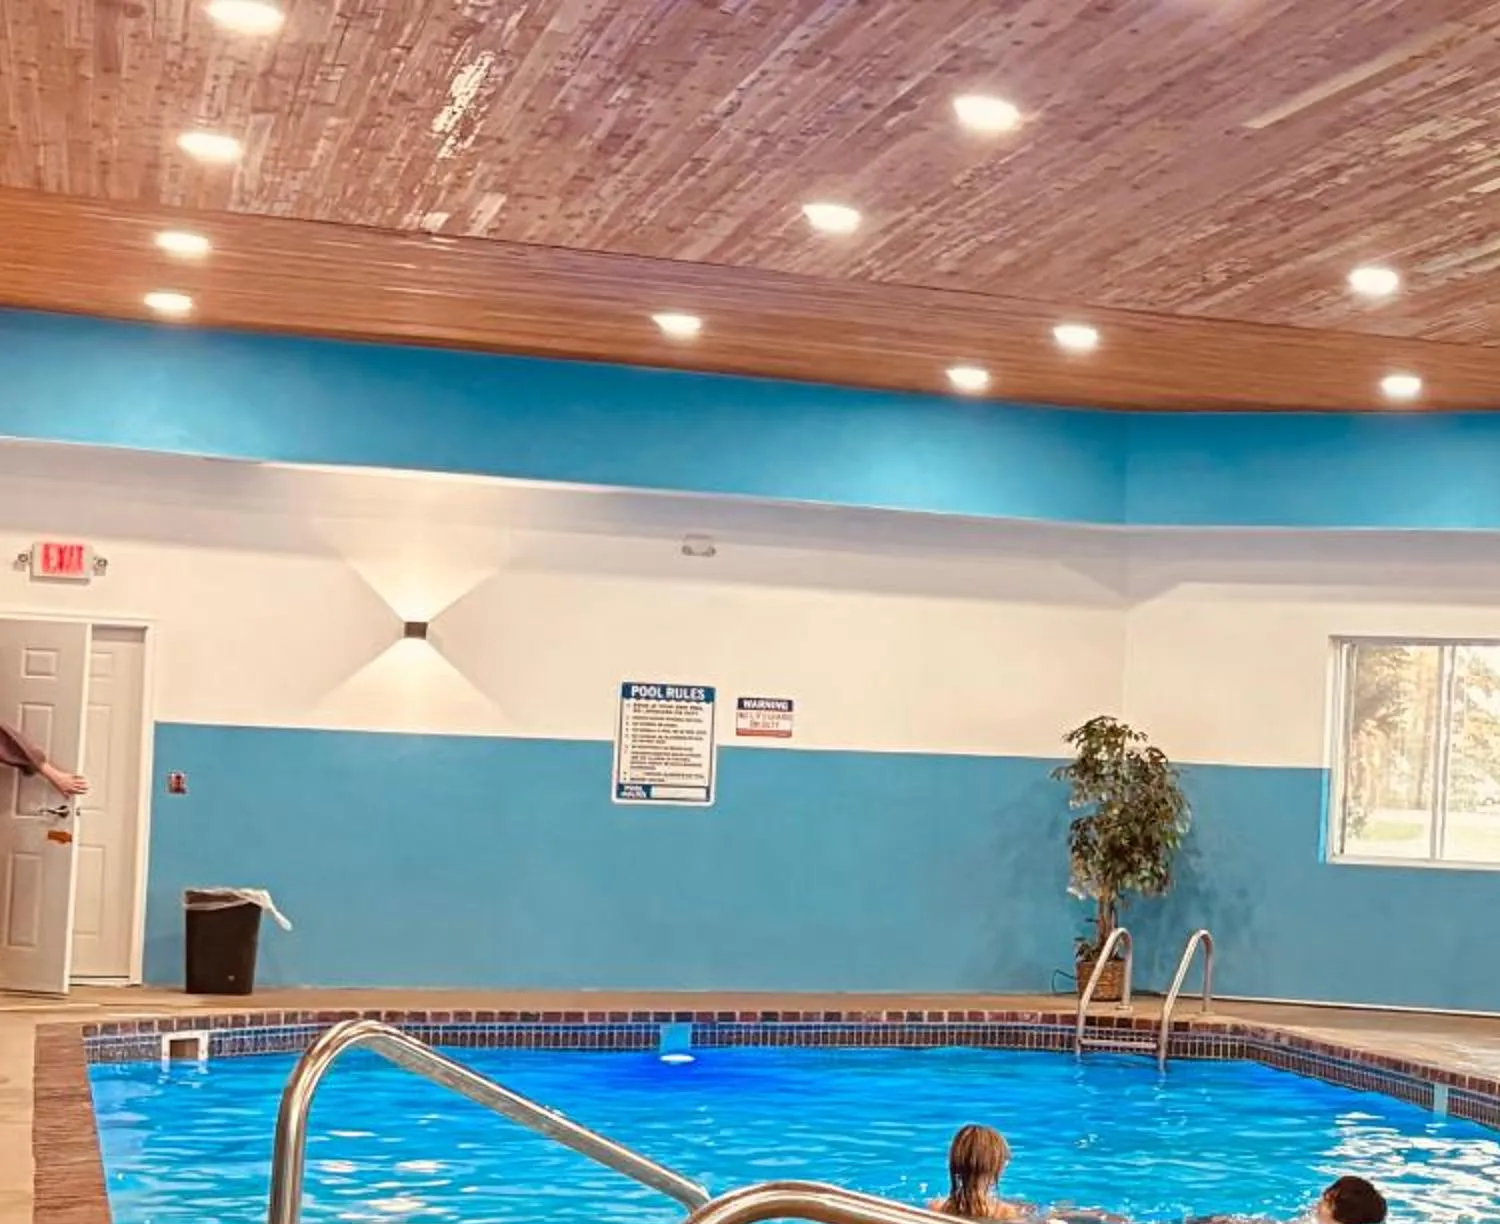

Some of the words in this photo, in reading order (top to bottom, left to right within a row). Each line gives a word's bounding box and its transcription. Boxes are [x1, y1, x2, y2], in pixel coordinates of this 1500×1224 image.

[42, 543, 84, 574] EXIT
[631, 685, 664, 699] POOL
[665, 687, 705, 700] RULES
[743, 700, 789, 710] WARNING
